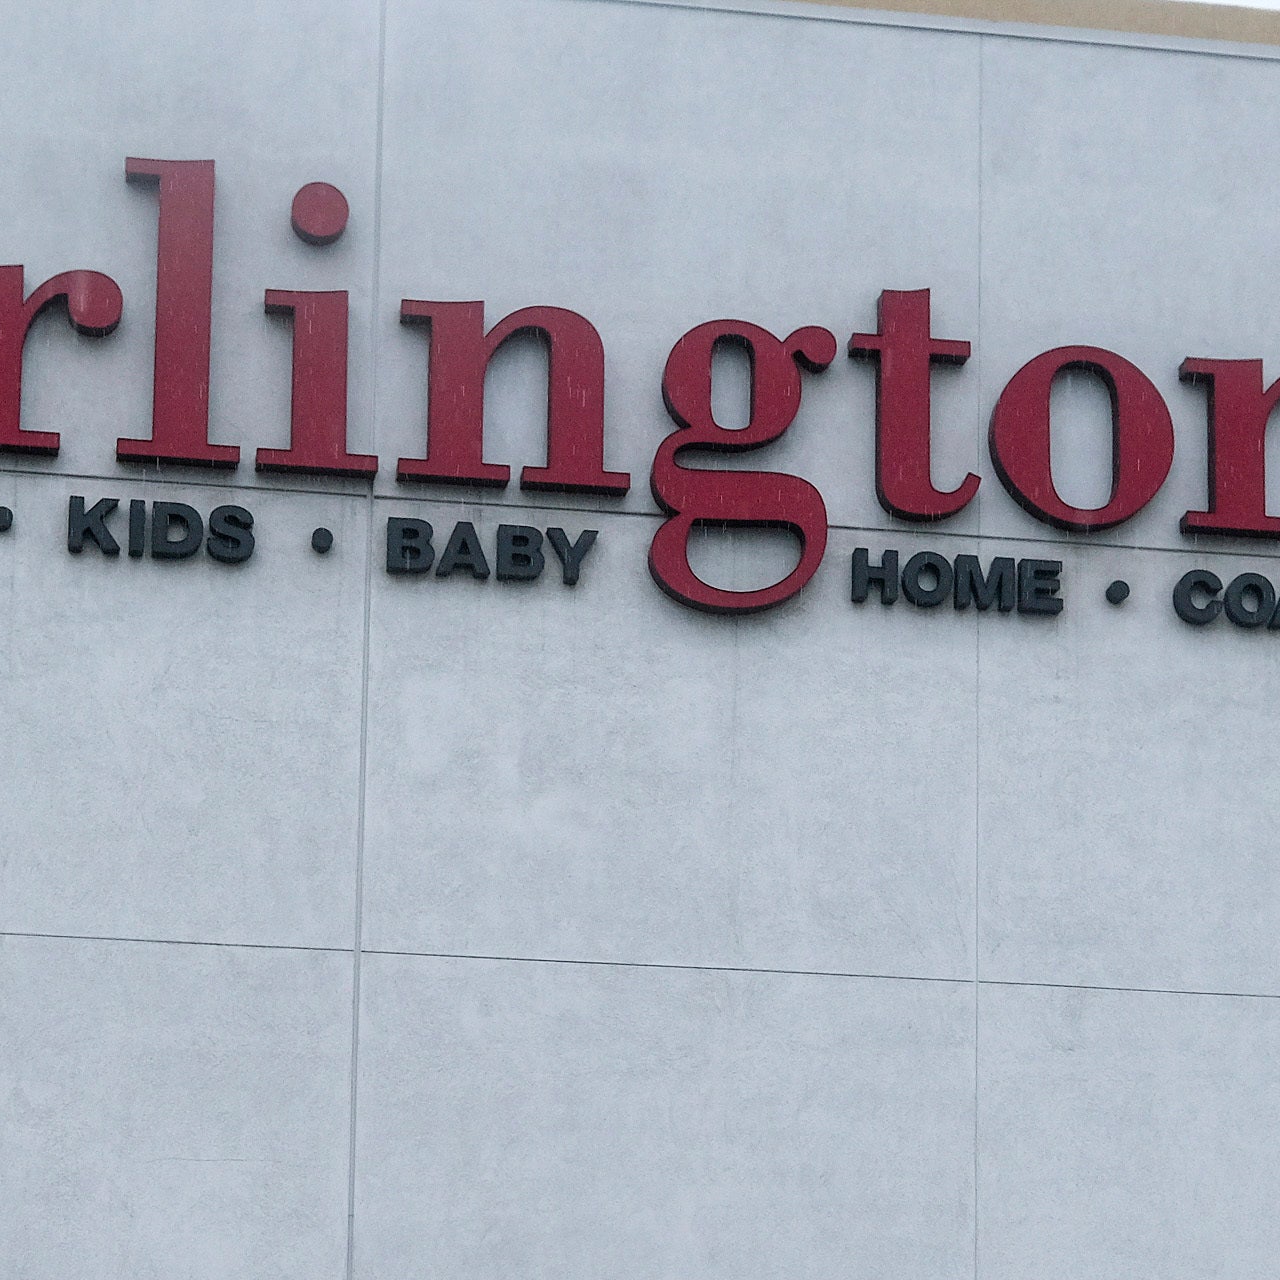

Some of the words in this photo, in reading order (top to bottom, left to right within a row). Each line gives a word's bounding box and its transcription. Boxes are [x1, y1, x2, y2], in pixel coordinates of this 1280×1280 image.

[67, 495, 255, 564] KIDS
[386, 517, 598, 585] BABY
[851, 547, 1064, 615] HOME
